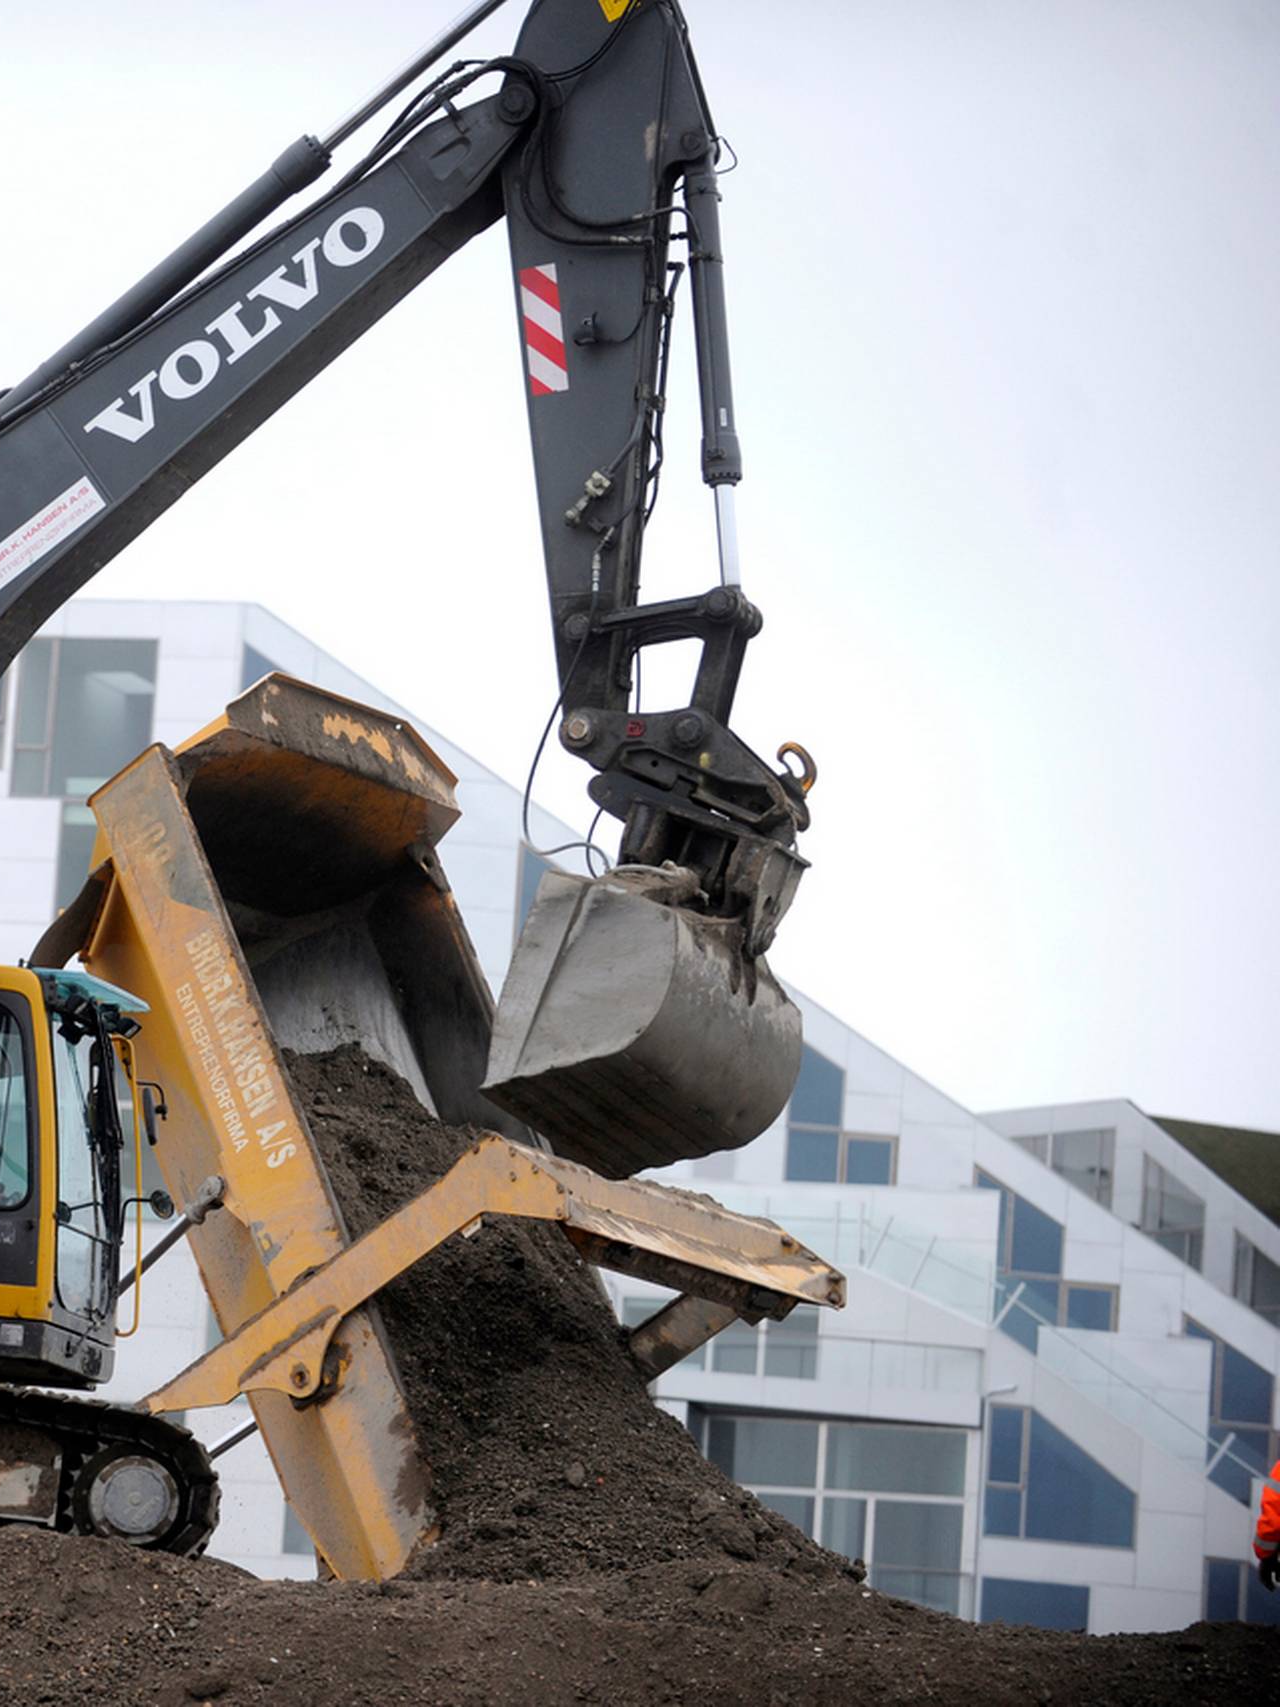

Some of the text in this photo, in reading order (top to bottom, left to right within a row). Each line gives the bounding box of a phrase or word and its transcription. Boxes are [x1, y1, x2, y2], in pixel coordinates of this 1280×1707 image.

[83, 206, 385, 443] VOLVO
[23, 503, 68, 540] HANSEN
[255, 1119, 297, 1169] A/S
